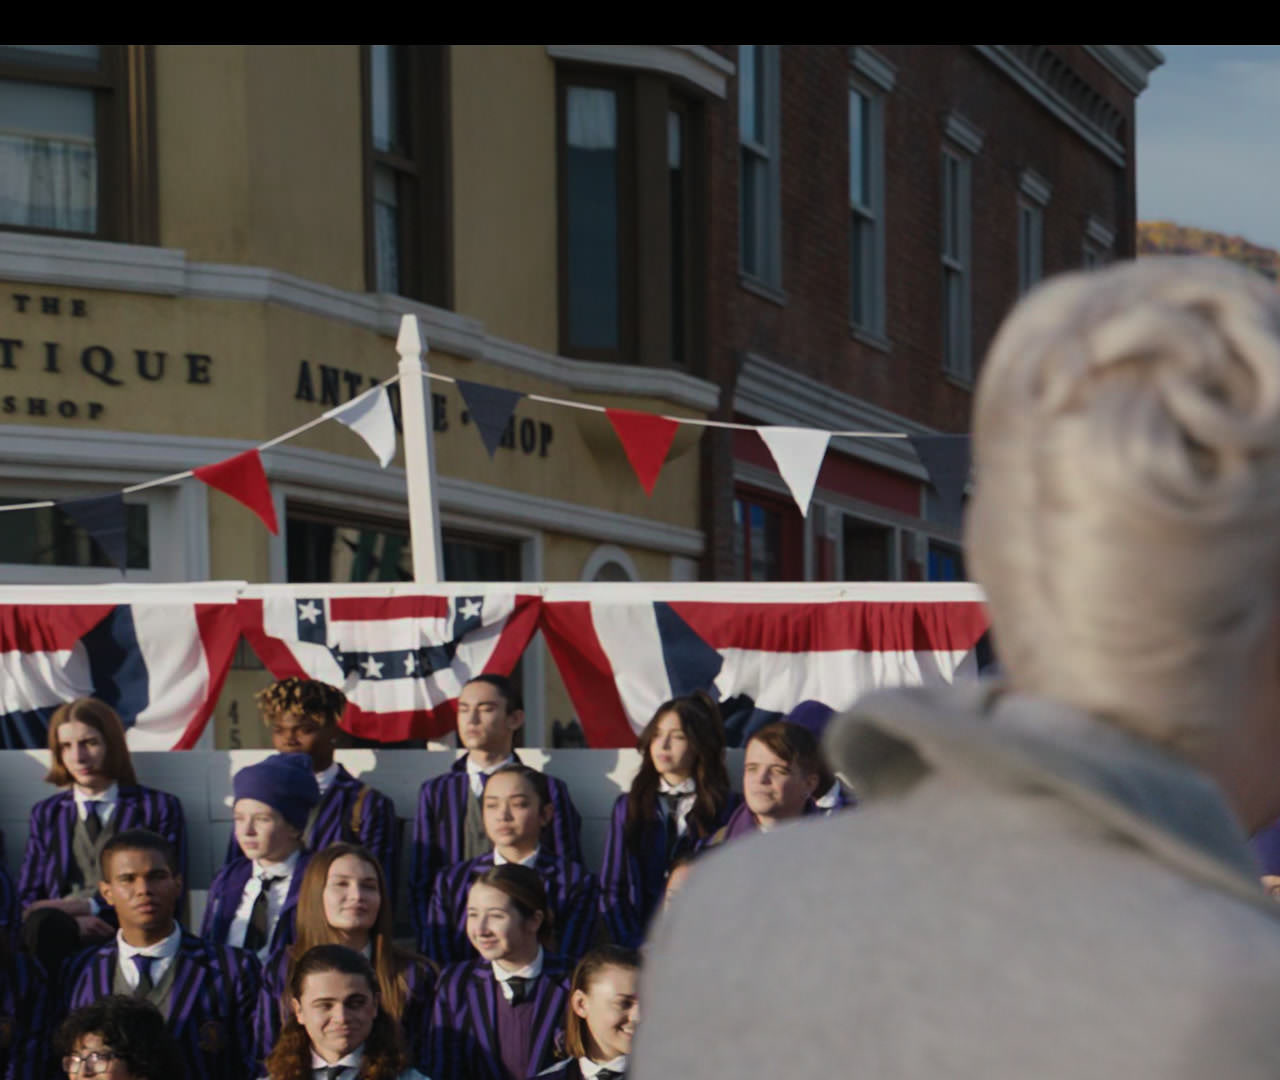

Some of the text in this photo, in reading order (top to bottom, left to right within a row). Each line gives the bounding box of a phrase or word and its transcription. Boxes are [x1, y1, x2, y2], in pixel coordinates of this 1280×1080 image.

[12, 294, 88, 317] THE
[0, 338, 213, 387] TIQUE
[2, 396, 105, 421] SHOP
[295, 359, 449, 434] ANTE
